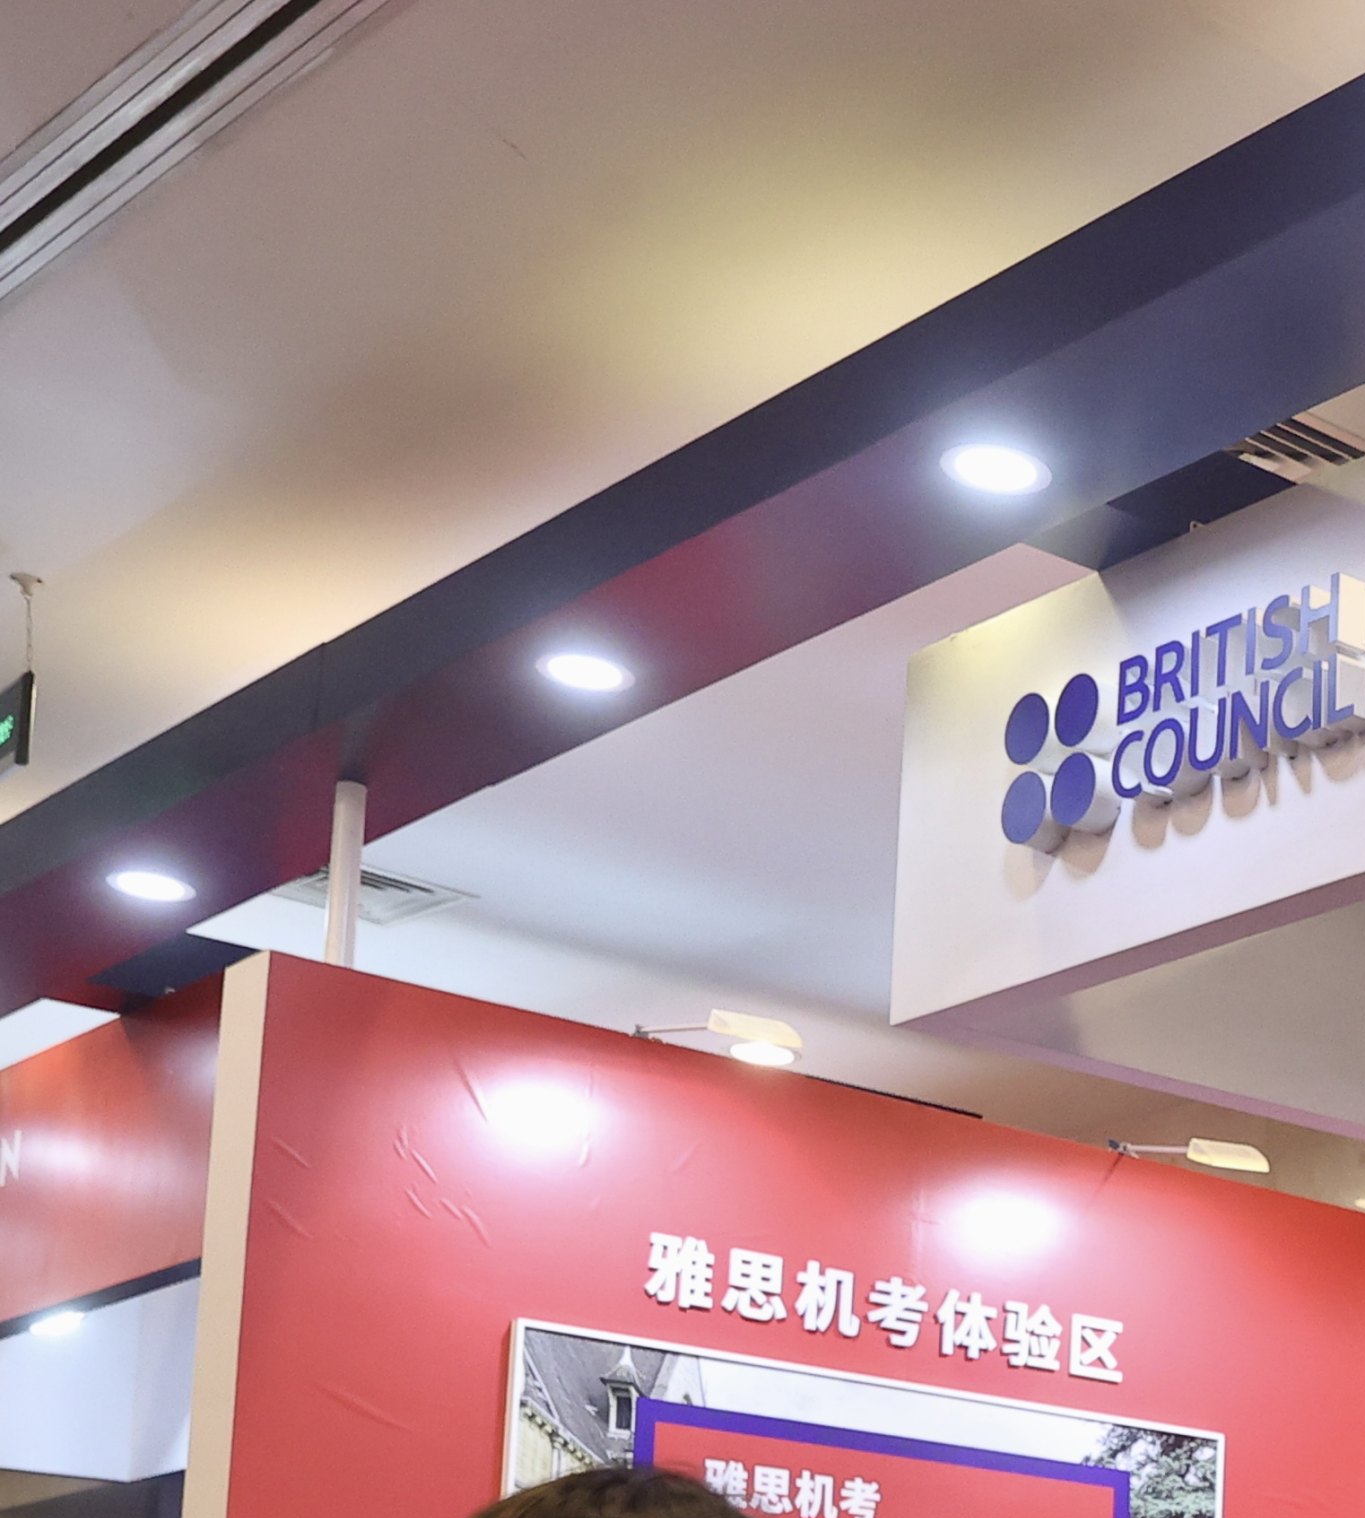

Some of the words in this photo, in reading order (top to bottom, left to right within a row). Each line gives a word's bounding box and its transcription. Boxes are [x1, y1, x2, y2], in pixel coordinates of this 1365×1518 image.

[1115, 572, 1340, 726] BRITISH
[1110, 655, 1354, 800] COUNCIL
[643, 1231, 1126, 1385] 雅思机考体验区
